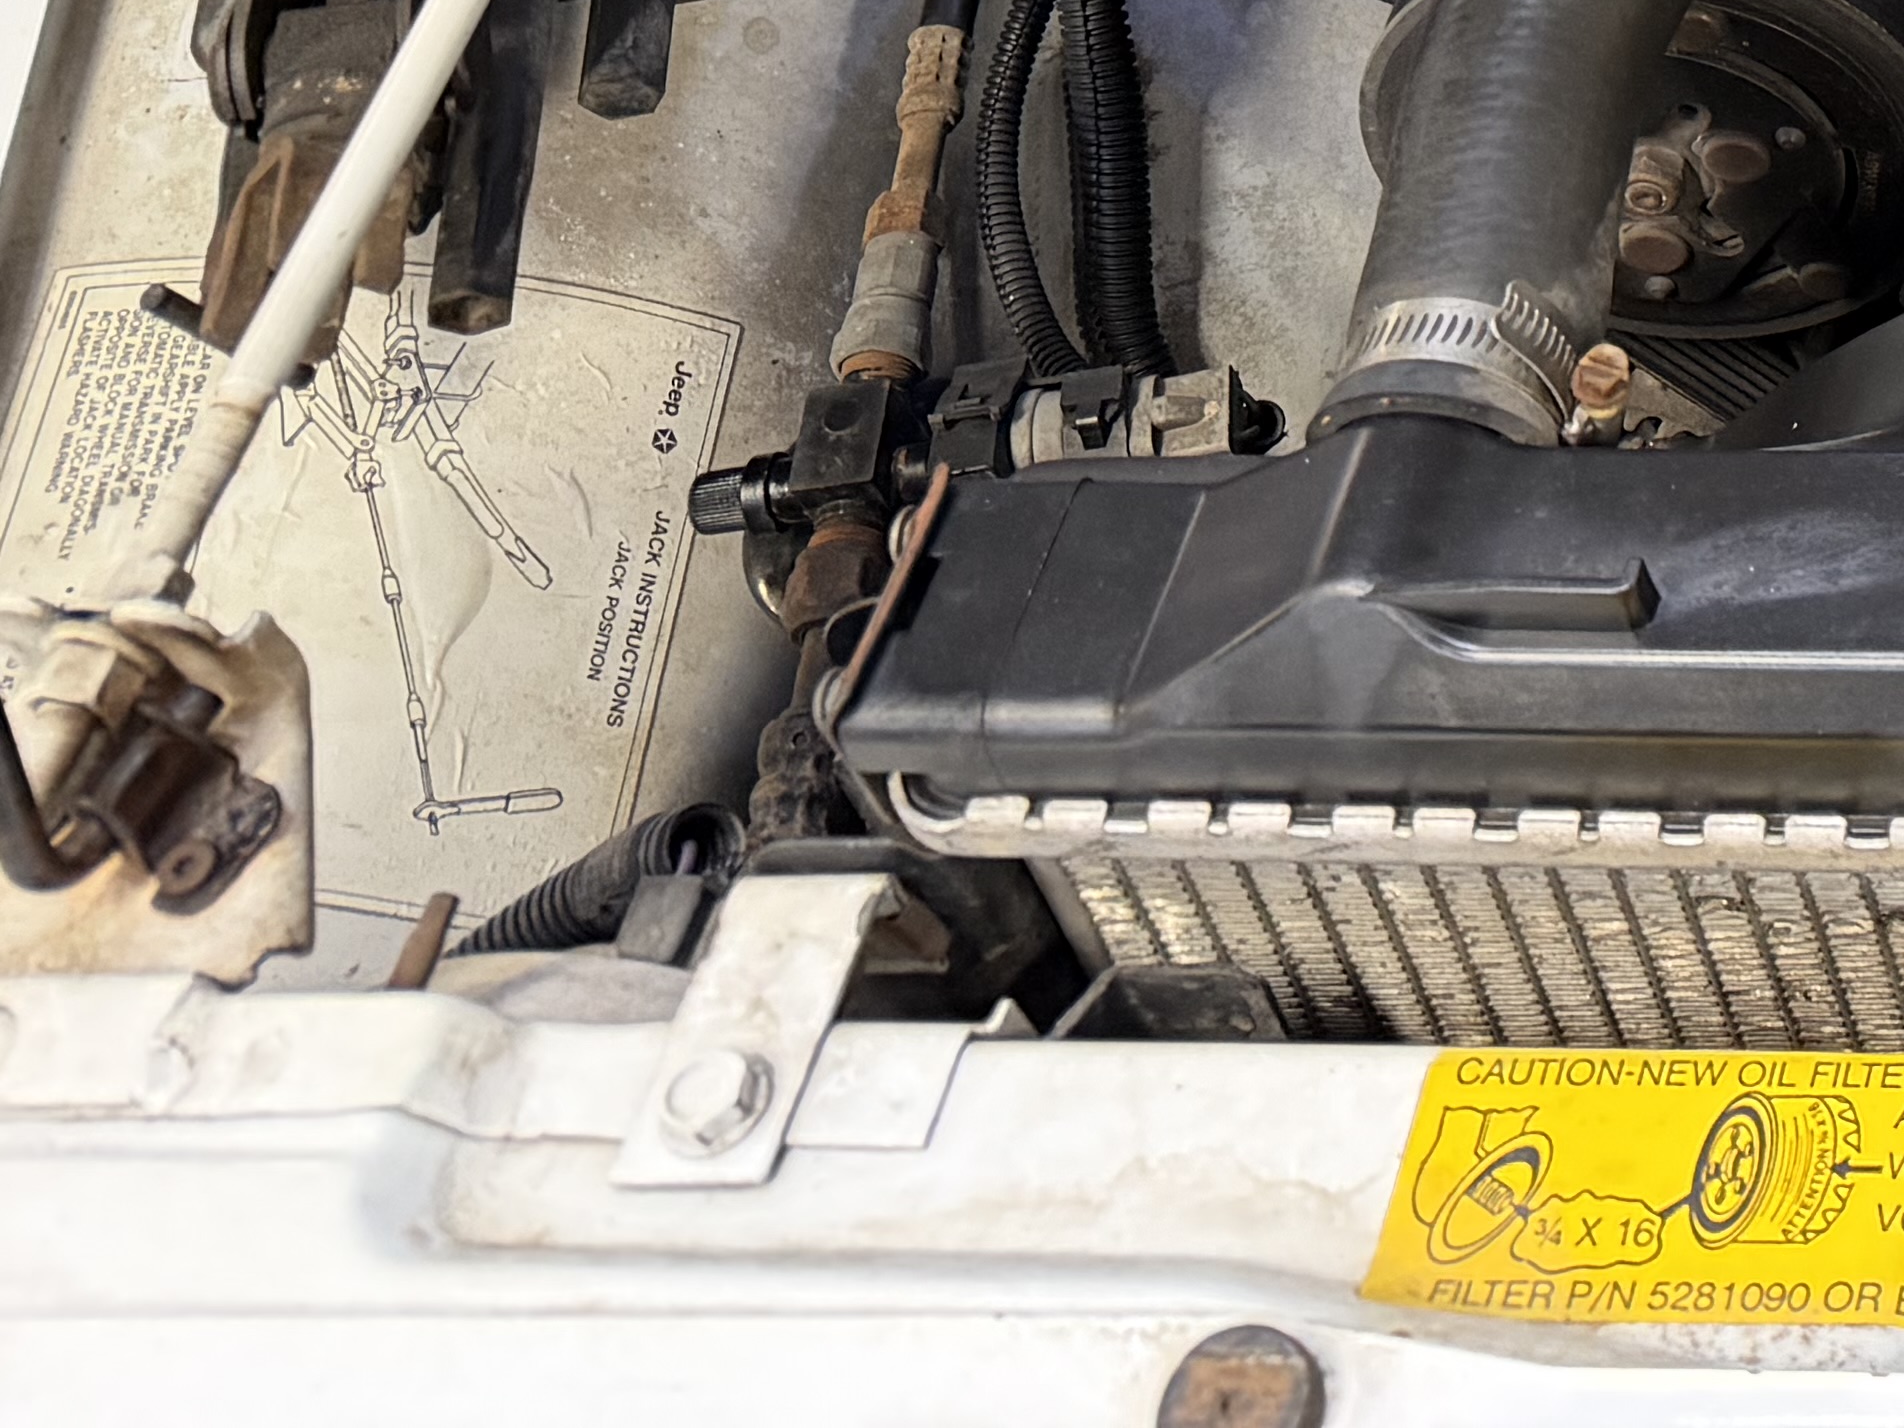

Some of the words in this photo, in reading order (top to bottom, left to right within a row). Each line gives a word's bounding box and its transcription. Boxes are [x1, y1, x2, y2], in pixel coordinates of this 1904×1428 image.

[193, 375, 206, 394] ON
[662, 361, 692, 416] Jeep
[177, 398, 199, 439] LEVEL
[59, 436, 89, 504] LOCATION
[59, 475, 94, 560] DIAGONALLY
[648, 511, 670, 567] JACK
[609, 541, 632, 592] JACK
[586, 596, 619, 682] POSITION
[606, 574, 658, 728] INSTRUCTIONS
[1457, 1057, 1728, 1086] CAUTION-NEW
[1738, 1060, 1797, 1087] OIL
[1781, 1148, 1831, 1242] ATTENTION
[1575, 1218, 1601, 1246] X
[1618, 1218, 1654, 1246] 16
[1427, 1278, 1555, 1310] FILTER
[1566, 1280, 1638, 1312] P/N
[1646, 1280, 1811, 1312] 5281090
[1823, 1280, 1883, 1312] OR
